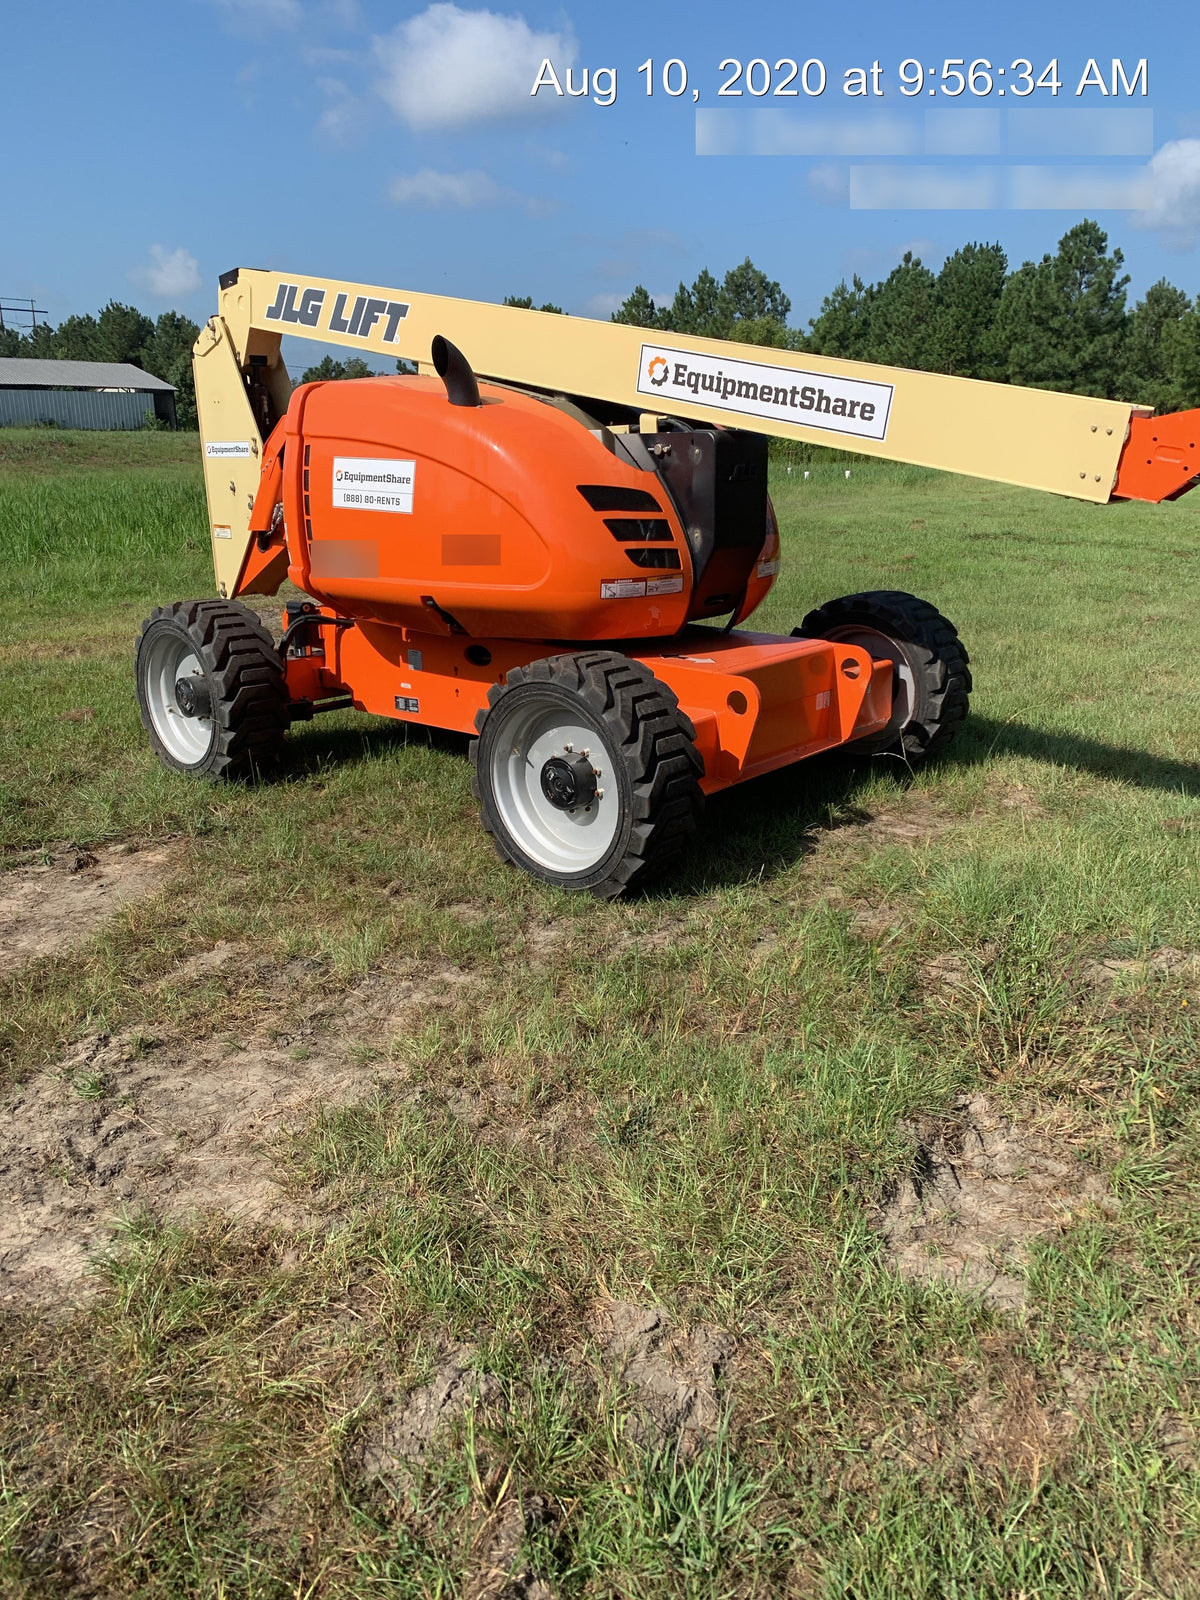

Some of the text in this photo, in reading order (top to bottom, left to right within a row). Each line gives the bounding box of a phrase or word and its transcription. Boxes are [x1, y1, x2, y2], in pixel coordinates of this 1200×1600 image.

[265, 283, 410, 343] JLG LIFT
[672, 363, 876, 422] EquipmentShare
[343, 471, 411, 485] EquipmentShare
[343, 493, 401, 507] (888) 80-RENTS
